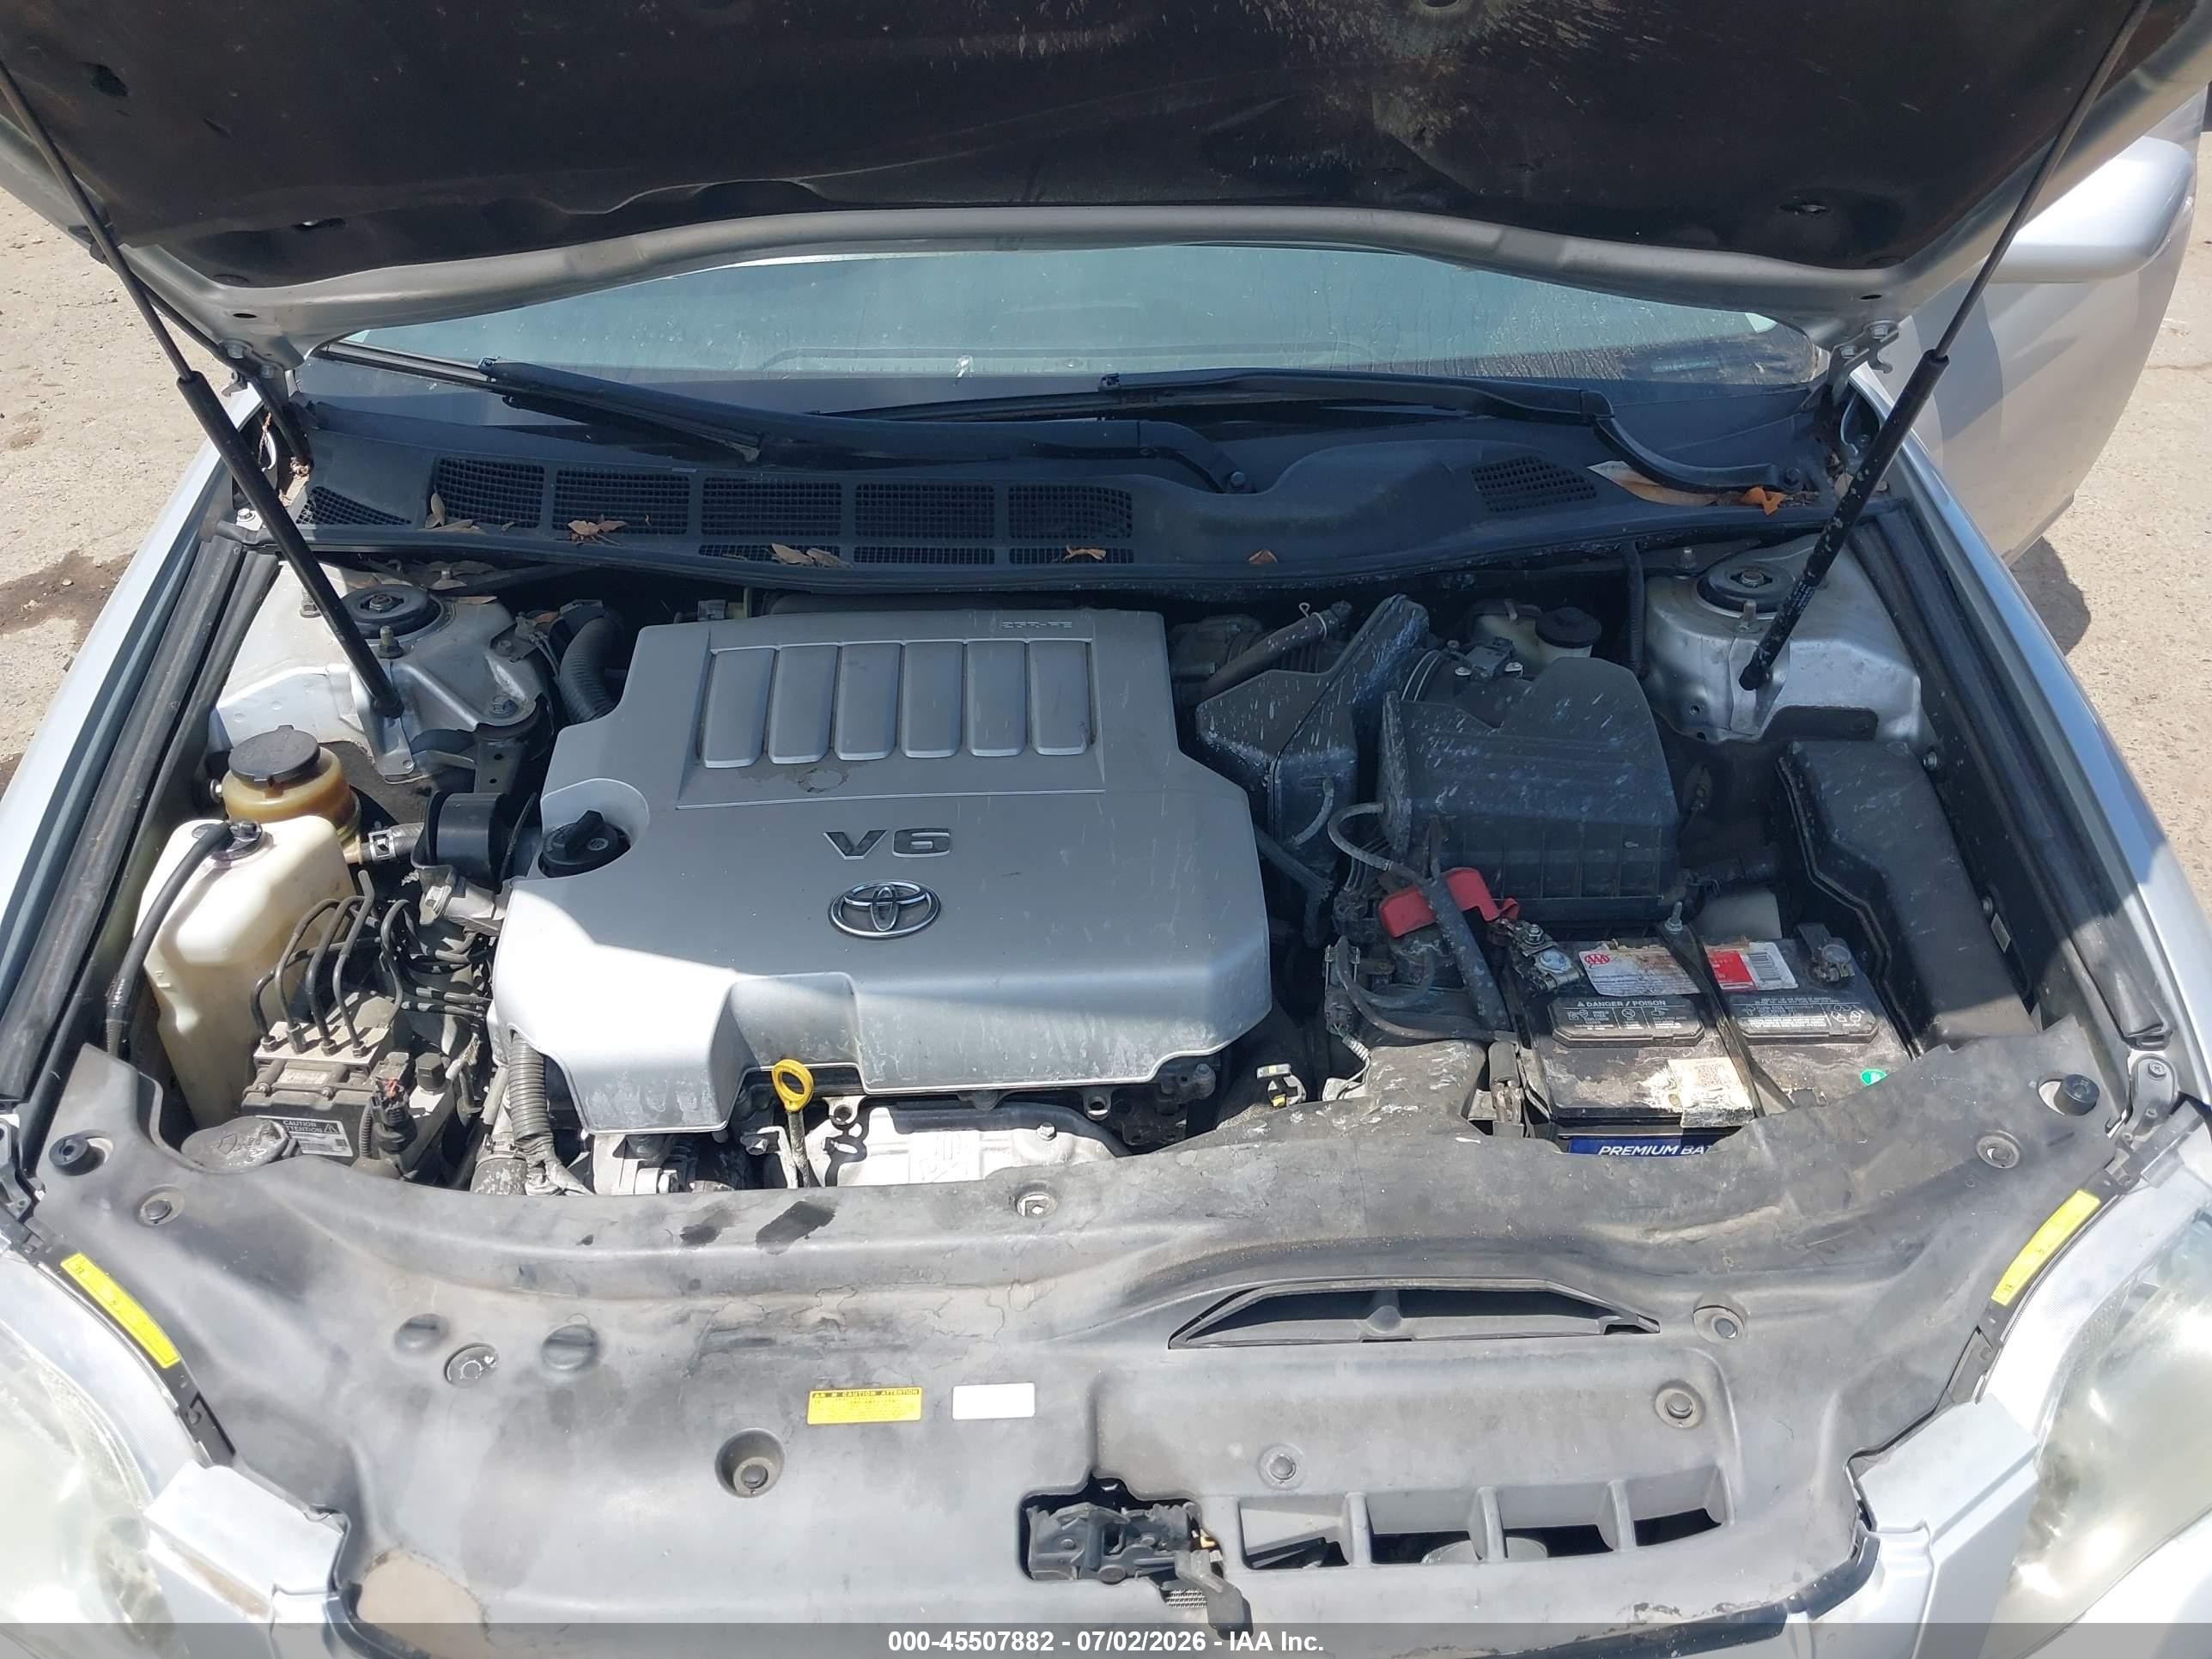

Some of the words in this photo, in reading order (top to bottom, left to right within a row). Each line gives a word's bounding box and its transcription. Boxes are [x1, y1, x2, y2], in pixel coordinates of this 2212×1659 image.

[823, 827, 951, 860] V6
[1585, 954, 1610, 964] AAA
[1598, 1145, 1680, 1156] PREMIUM
